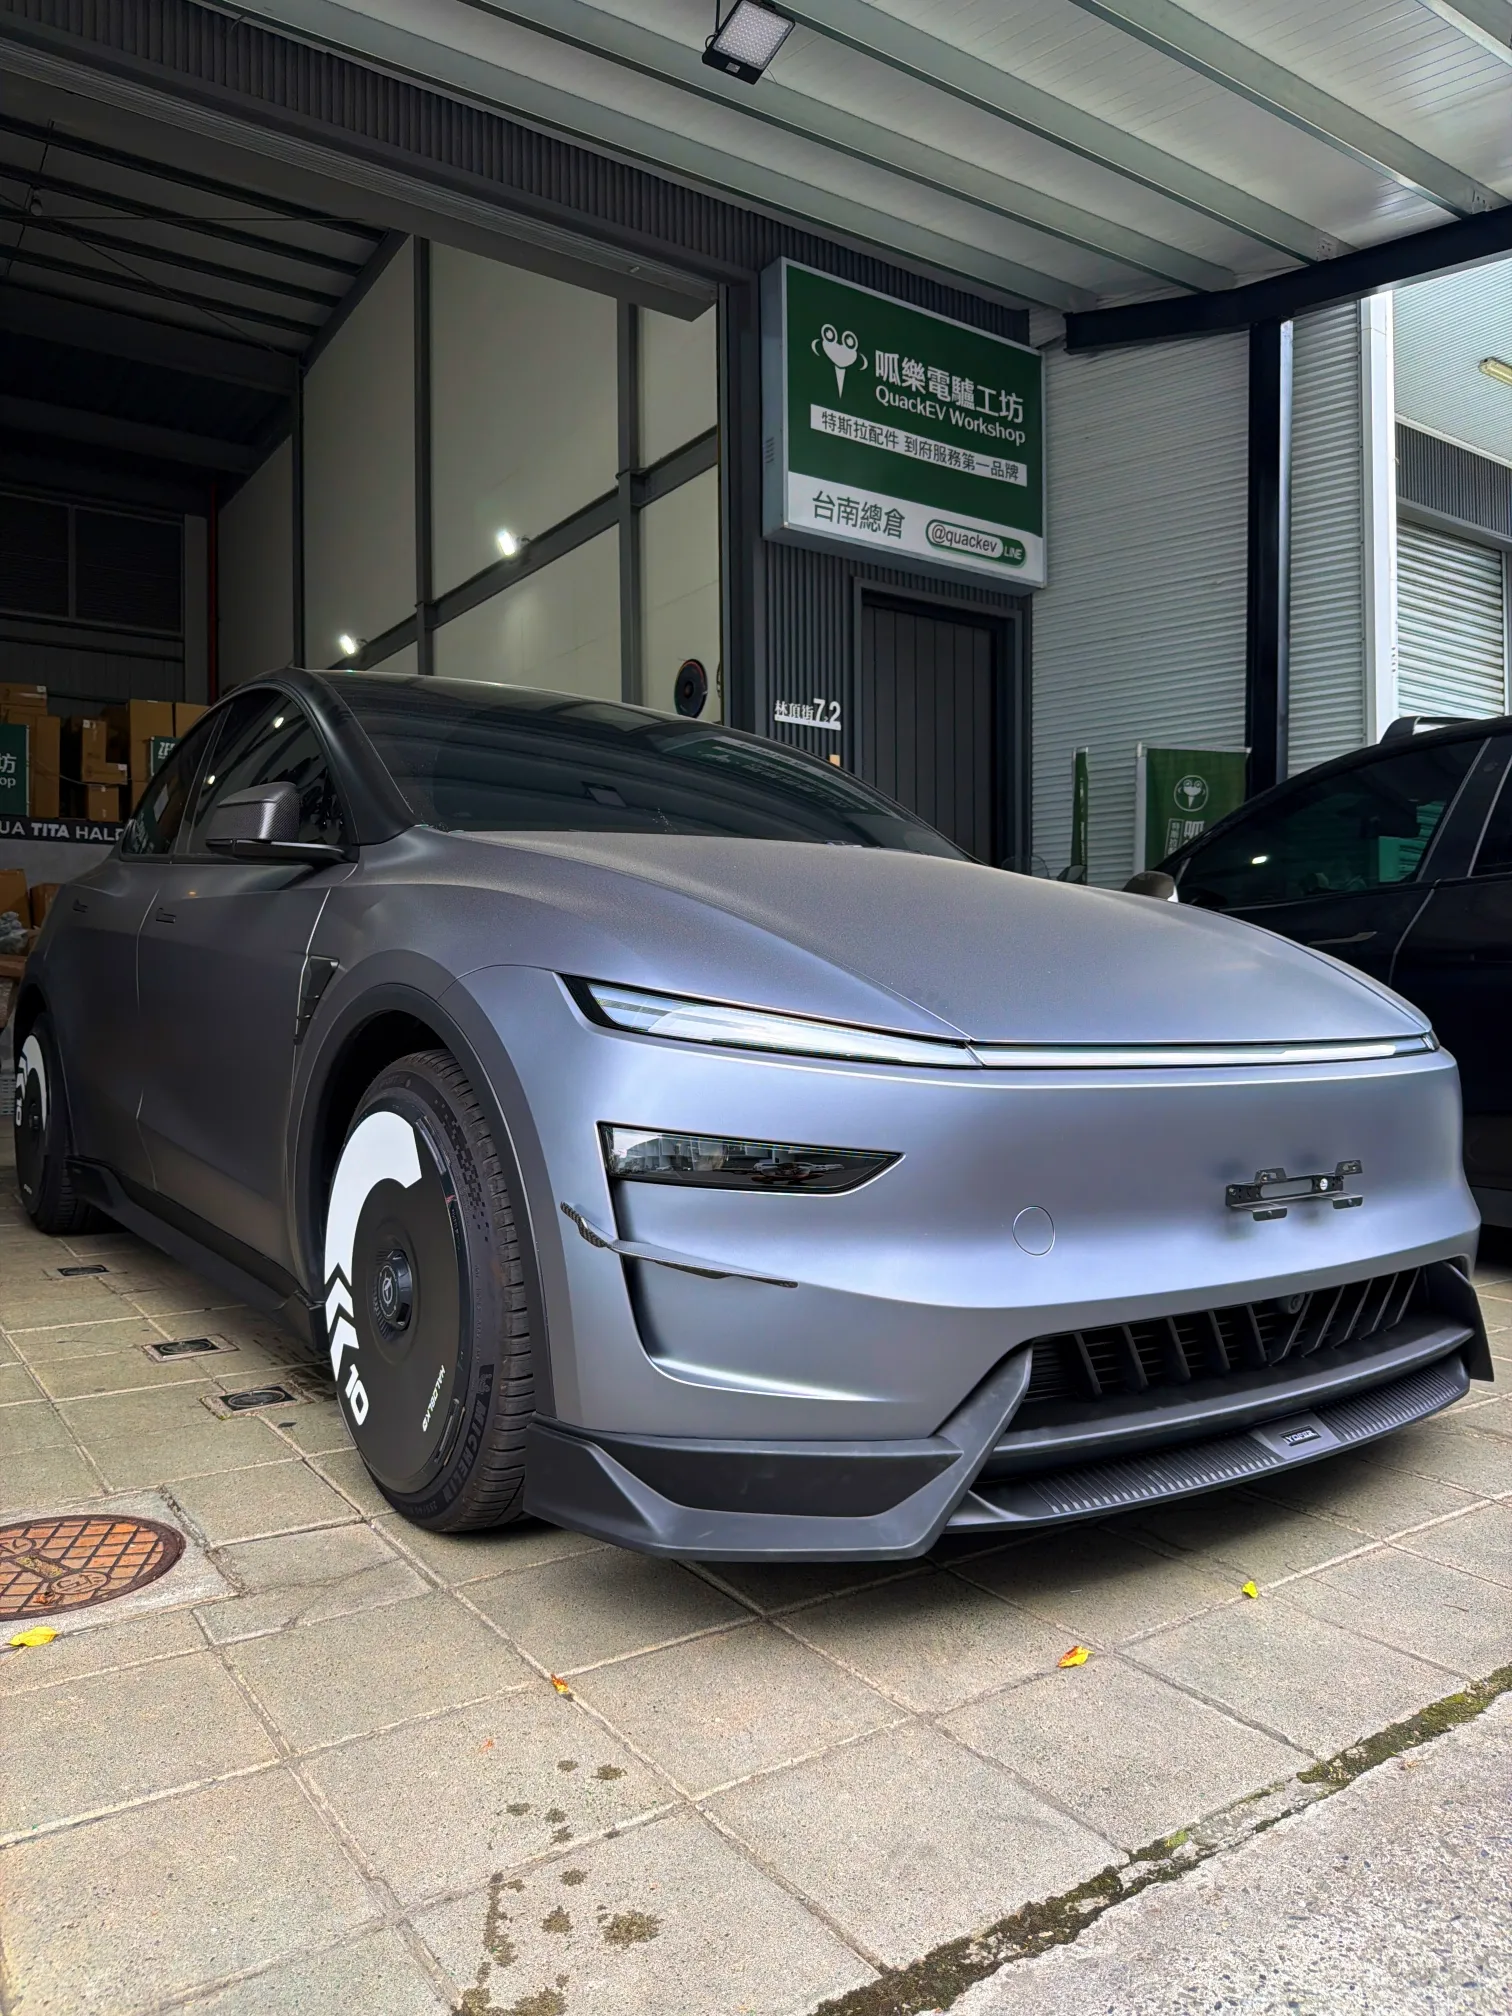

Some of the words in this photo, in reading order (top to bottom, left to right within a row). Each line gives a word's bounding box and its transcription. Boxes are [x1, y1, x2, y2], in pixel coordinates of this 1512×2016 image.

[875, 350, 1024, 423] 呱樂電驢工坊
[875, 385, 946, 420] QuackEV
[949, 407, 1026, 446] Workshop
[821, 410, 900, 450] 特斯拉配件
[904, 434, 1019, 482] 到府服務第一品牌
[812, 490, 905, 539] 台南總倉
[931, 524, 998, 553] @quackev
[1003, 545, 1023, 561] LINE
[31, 821, 70, 839] TITA
[345, 1364, 369, 1426] 10
[442, 1399, 488, 1503] MICHELIN
